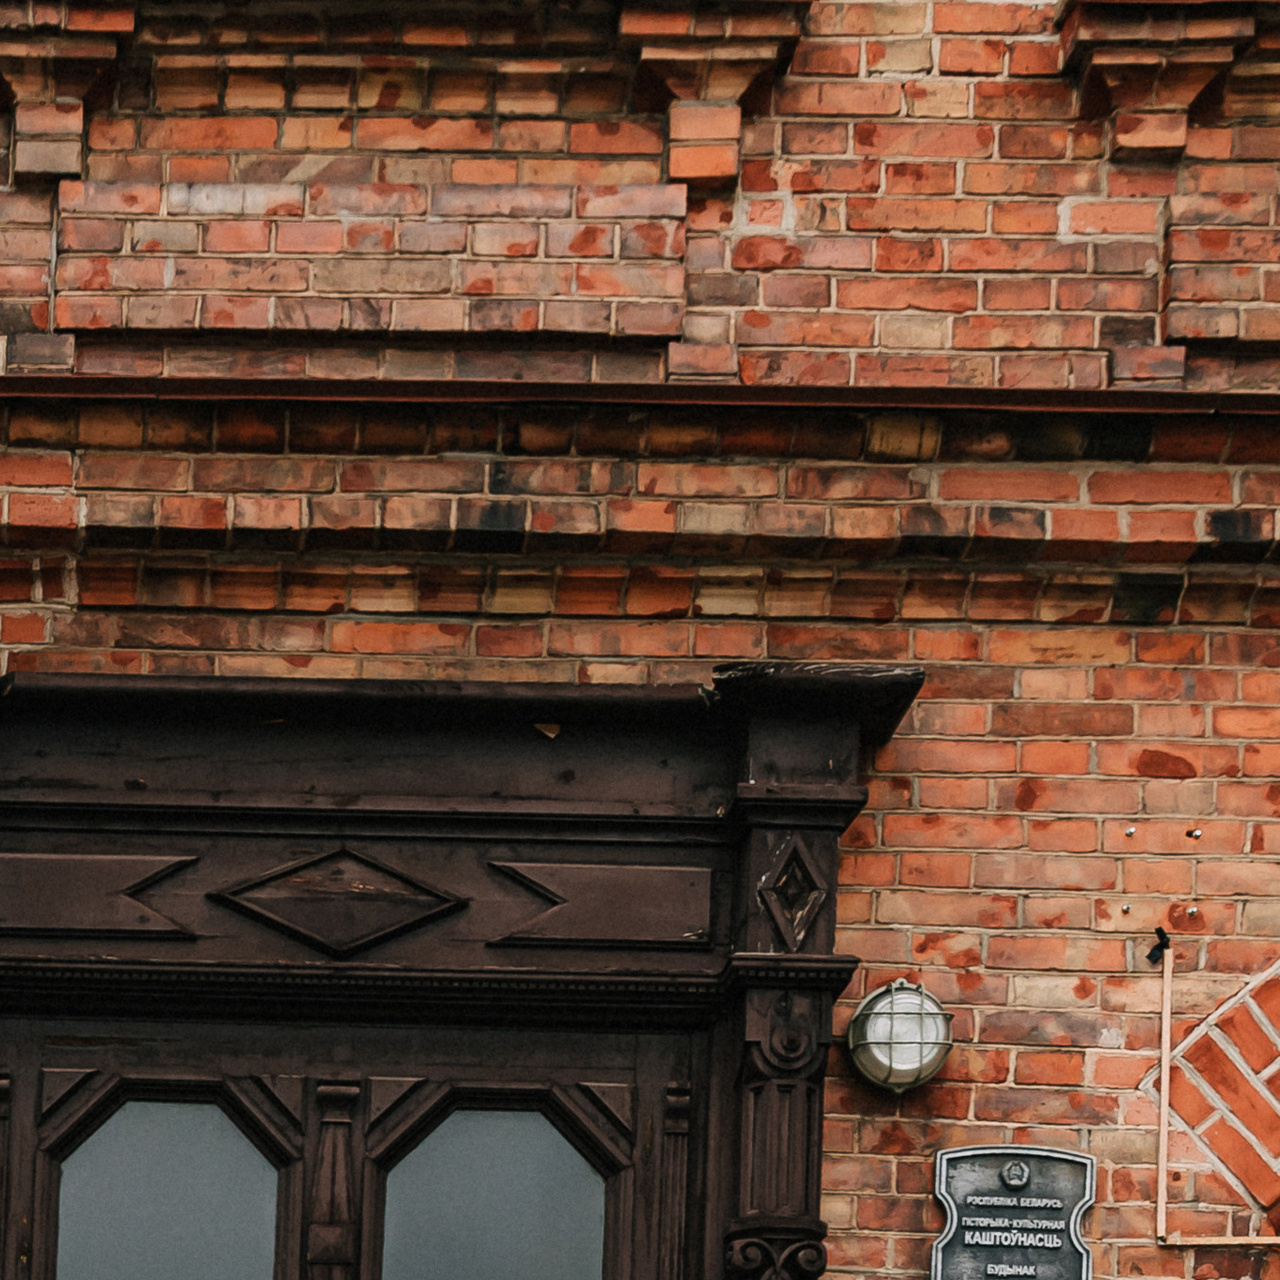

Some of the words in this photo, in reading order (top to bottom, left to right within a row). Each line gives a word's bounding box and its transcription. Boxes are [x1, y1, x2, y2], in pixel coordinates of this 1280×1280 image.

[1019, 1197, 1064, 1209] БЕЛАРУСЬ
[964, 1229, 1063, 1248] КАШТОЎНАСЦЬ
[986, 1263, 1036, 1277] БУДЫНАК
